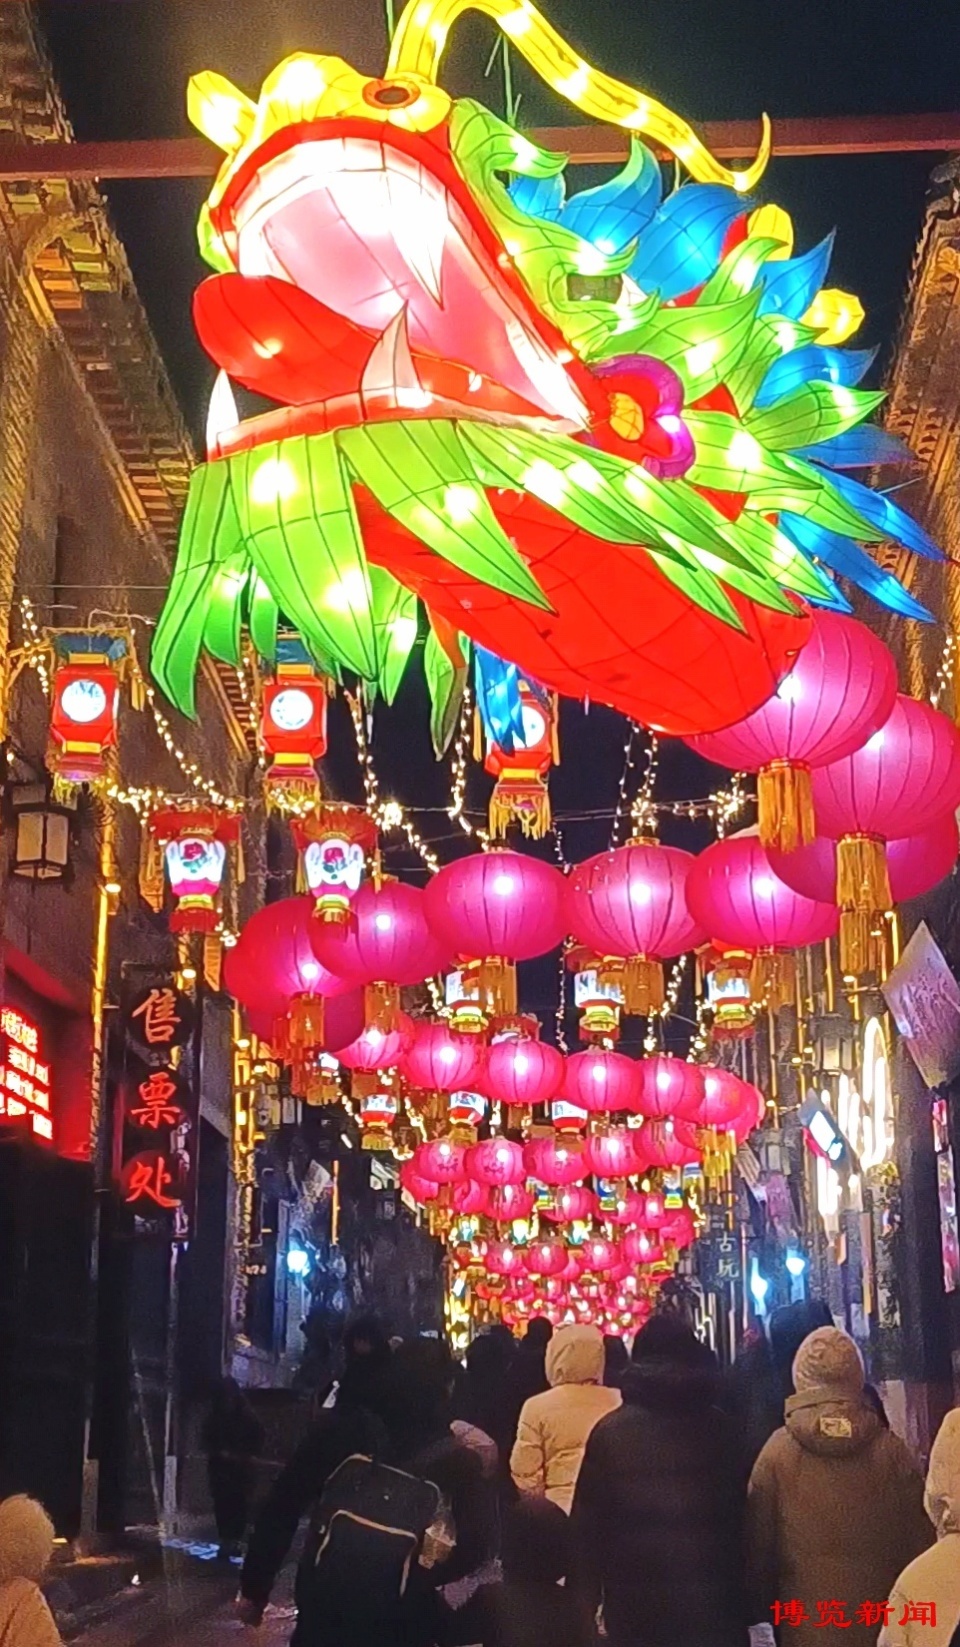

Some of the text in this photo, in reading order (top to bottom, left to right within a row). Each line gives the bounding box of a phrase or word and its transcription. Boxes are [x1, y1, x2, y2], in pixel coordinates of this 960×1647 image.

[126, 988, 182, 1208] 售票处
[715, 1231, 740, 1278] 古玩
